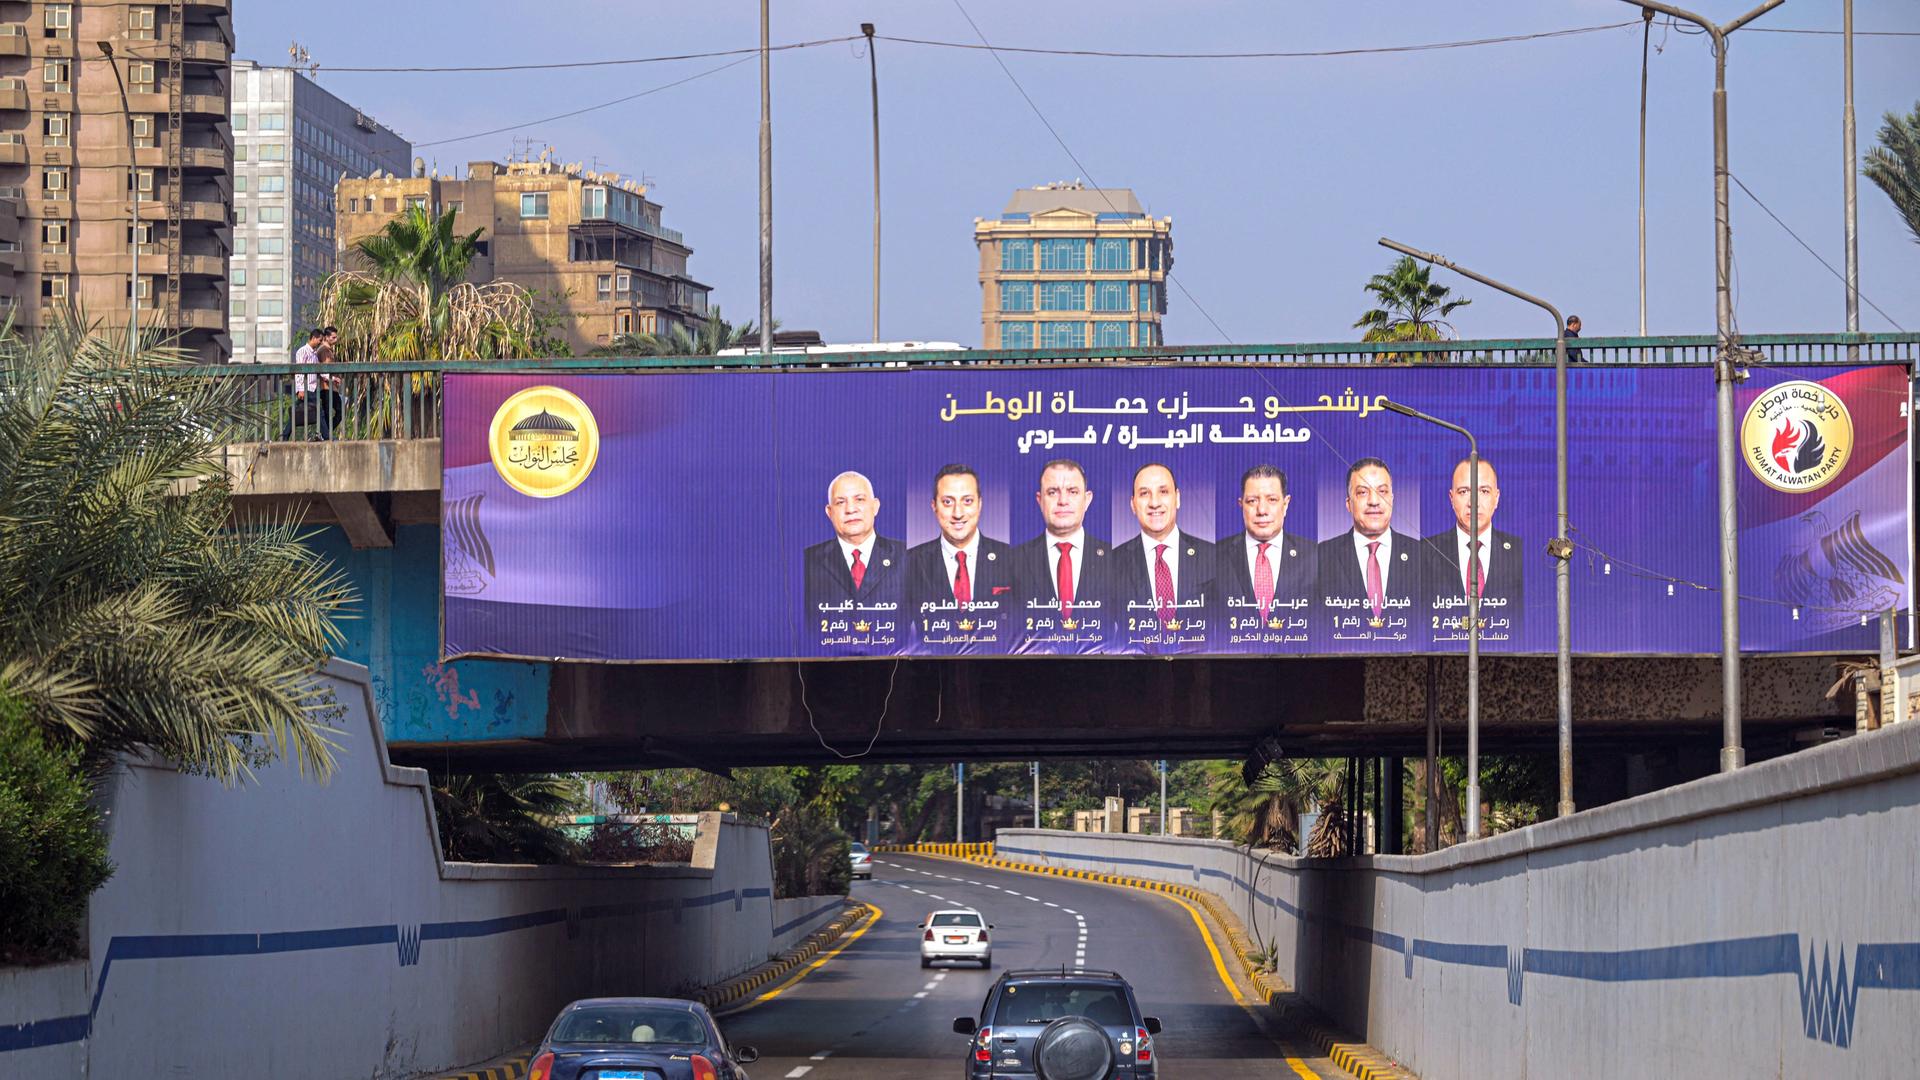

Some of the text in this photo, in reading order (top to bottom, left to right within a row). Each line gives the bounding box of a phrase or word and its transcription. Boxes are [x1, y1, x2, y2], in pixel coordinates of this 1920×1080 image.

[940, 387, 1388, 421] مرشحو حزب حماة الوطن
[1757, 391, 1788, 419] الوطن
[1017, 425, 1097, 453] فردي
[1118, 423, 1203, 449] الجيزة
[1209, 423, 1311, 443] محافظة
[508, 445, 579, 470] مجلس النواب
[1753, 446, 1842, 485] HUMAT ALWATAN PARTY
[818, 600, 898, 613] محمد كليب
[920, 599, 1000, 614] محمود لملوم
[1026, 597, 1102, 611] محمد رشاد
[1227, 596, 1309, 612] عربي زيادة
[1325, 596, 1361, 609] عريضة
[1381, 596, 1411, 609] فيصل
[821, 619, 895, 633] رمز رقم 2
[922, 618, 997, 632] رمز رقم 1
[1026, 617, 1101, 631] رمز رقم 2
[1128, 617, 1136, 631] 2
[1138, 618, 1157, 631] رقم
[1185, 618, 1206, 630] رمز
[1230, 616, 1237, 629] 3
[1240, 616, 1259, 630] رقم
[1287, 616, 1308, 629] رمز
[1333, 615, 1407, 629] رمز رقم 1
[1432, 616, 1440, 628] 2
[1489, 616, 1510, 629] رمز
[821, 635, 851, 645] النمرس
[871, 635, 895, 645] مركز
[924, 634, 997, 644] قسم العمرانية
[1025, 633, 1103, 643] مركز البدرشين
[1178, 633, 1206, 645] قسم
[1230, 633, 1309, 644] قسم بولاق الدكرور
[1333, 631, 1407, 641] مركز الصف
